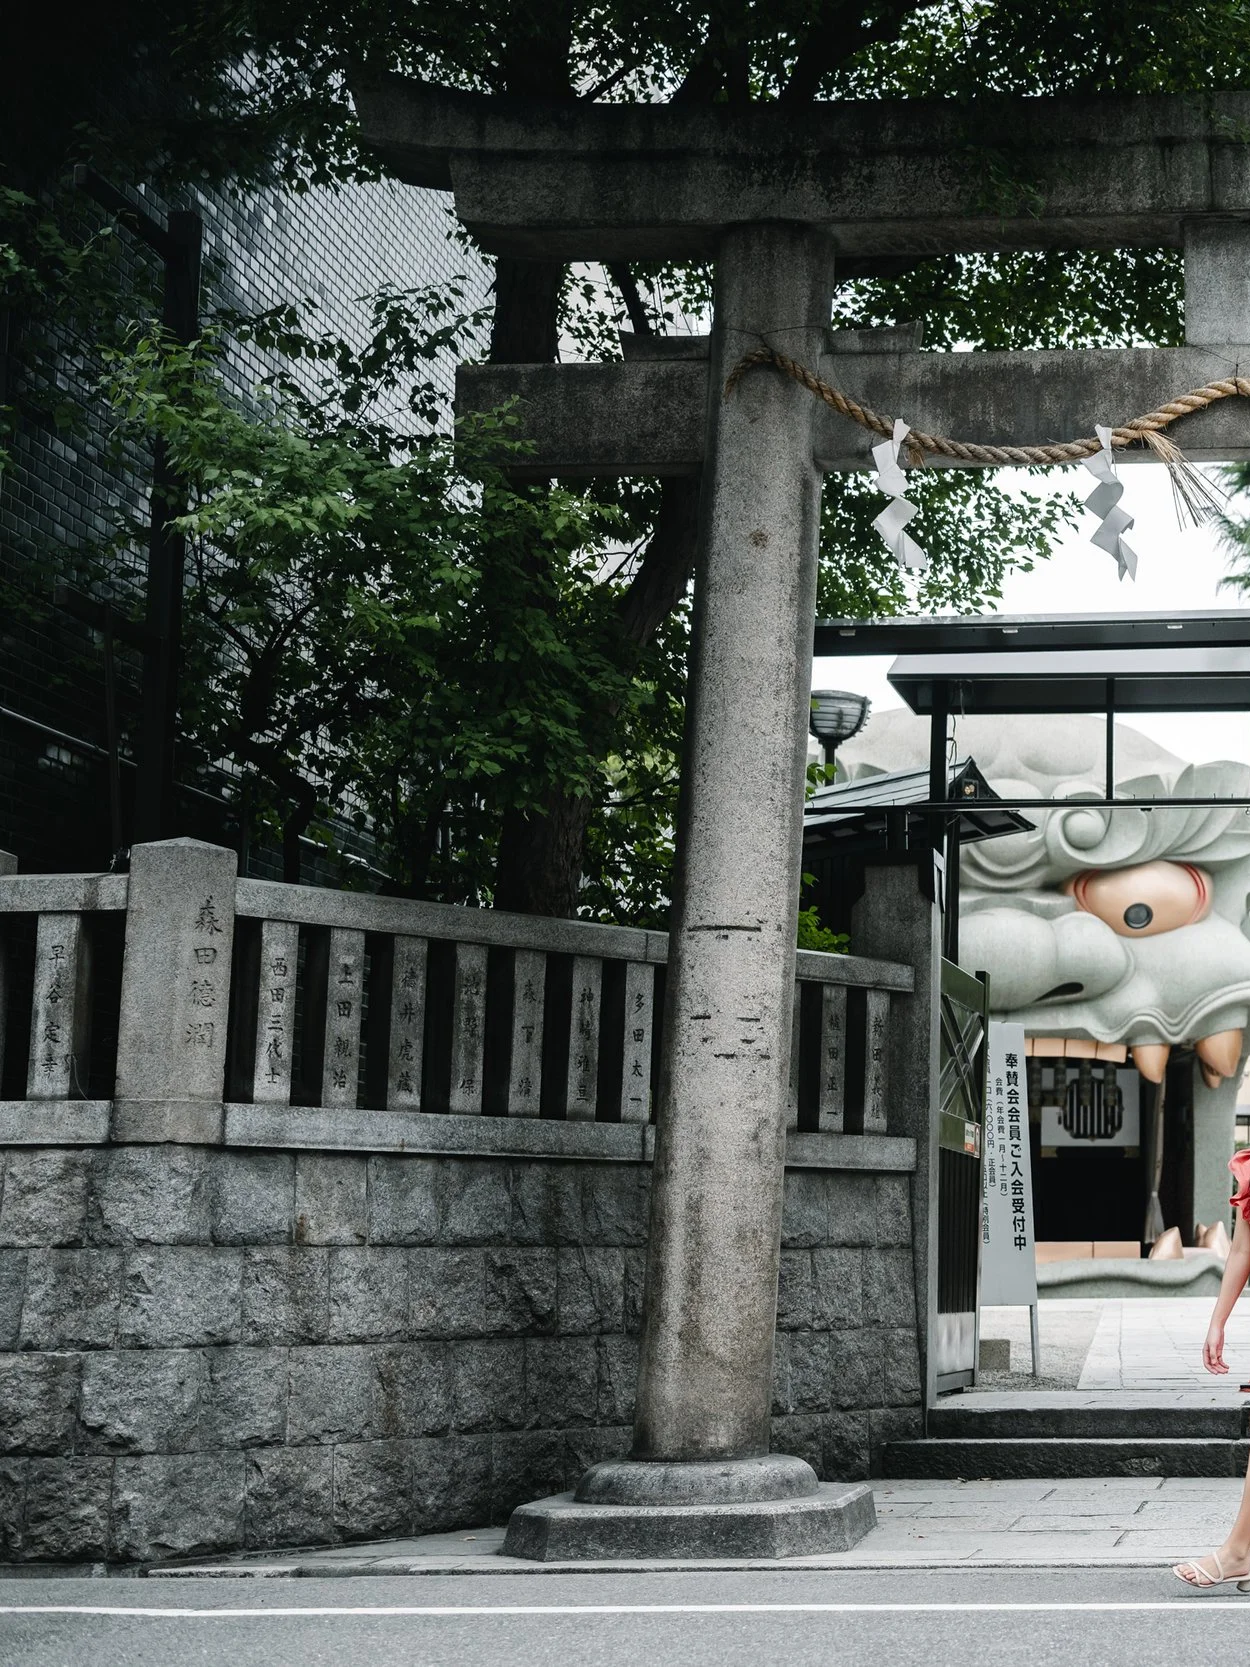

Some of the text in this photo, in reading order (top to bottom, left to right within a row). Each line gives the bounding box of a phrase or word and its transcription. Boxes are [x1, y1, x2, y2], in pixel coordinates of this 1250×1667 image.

[332, 962, 354, 1090] 上田親治
[628, 992, 645, 1103] 多田太一
[1005, 1053, 1027, 1252] 奉賛会会員ご入会受付中
